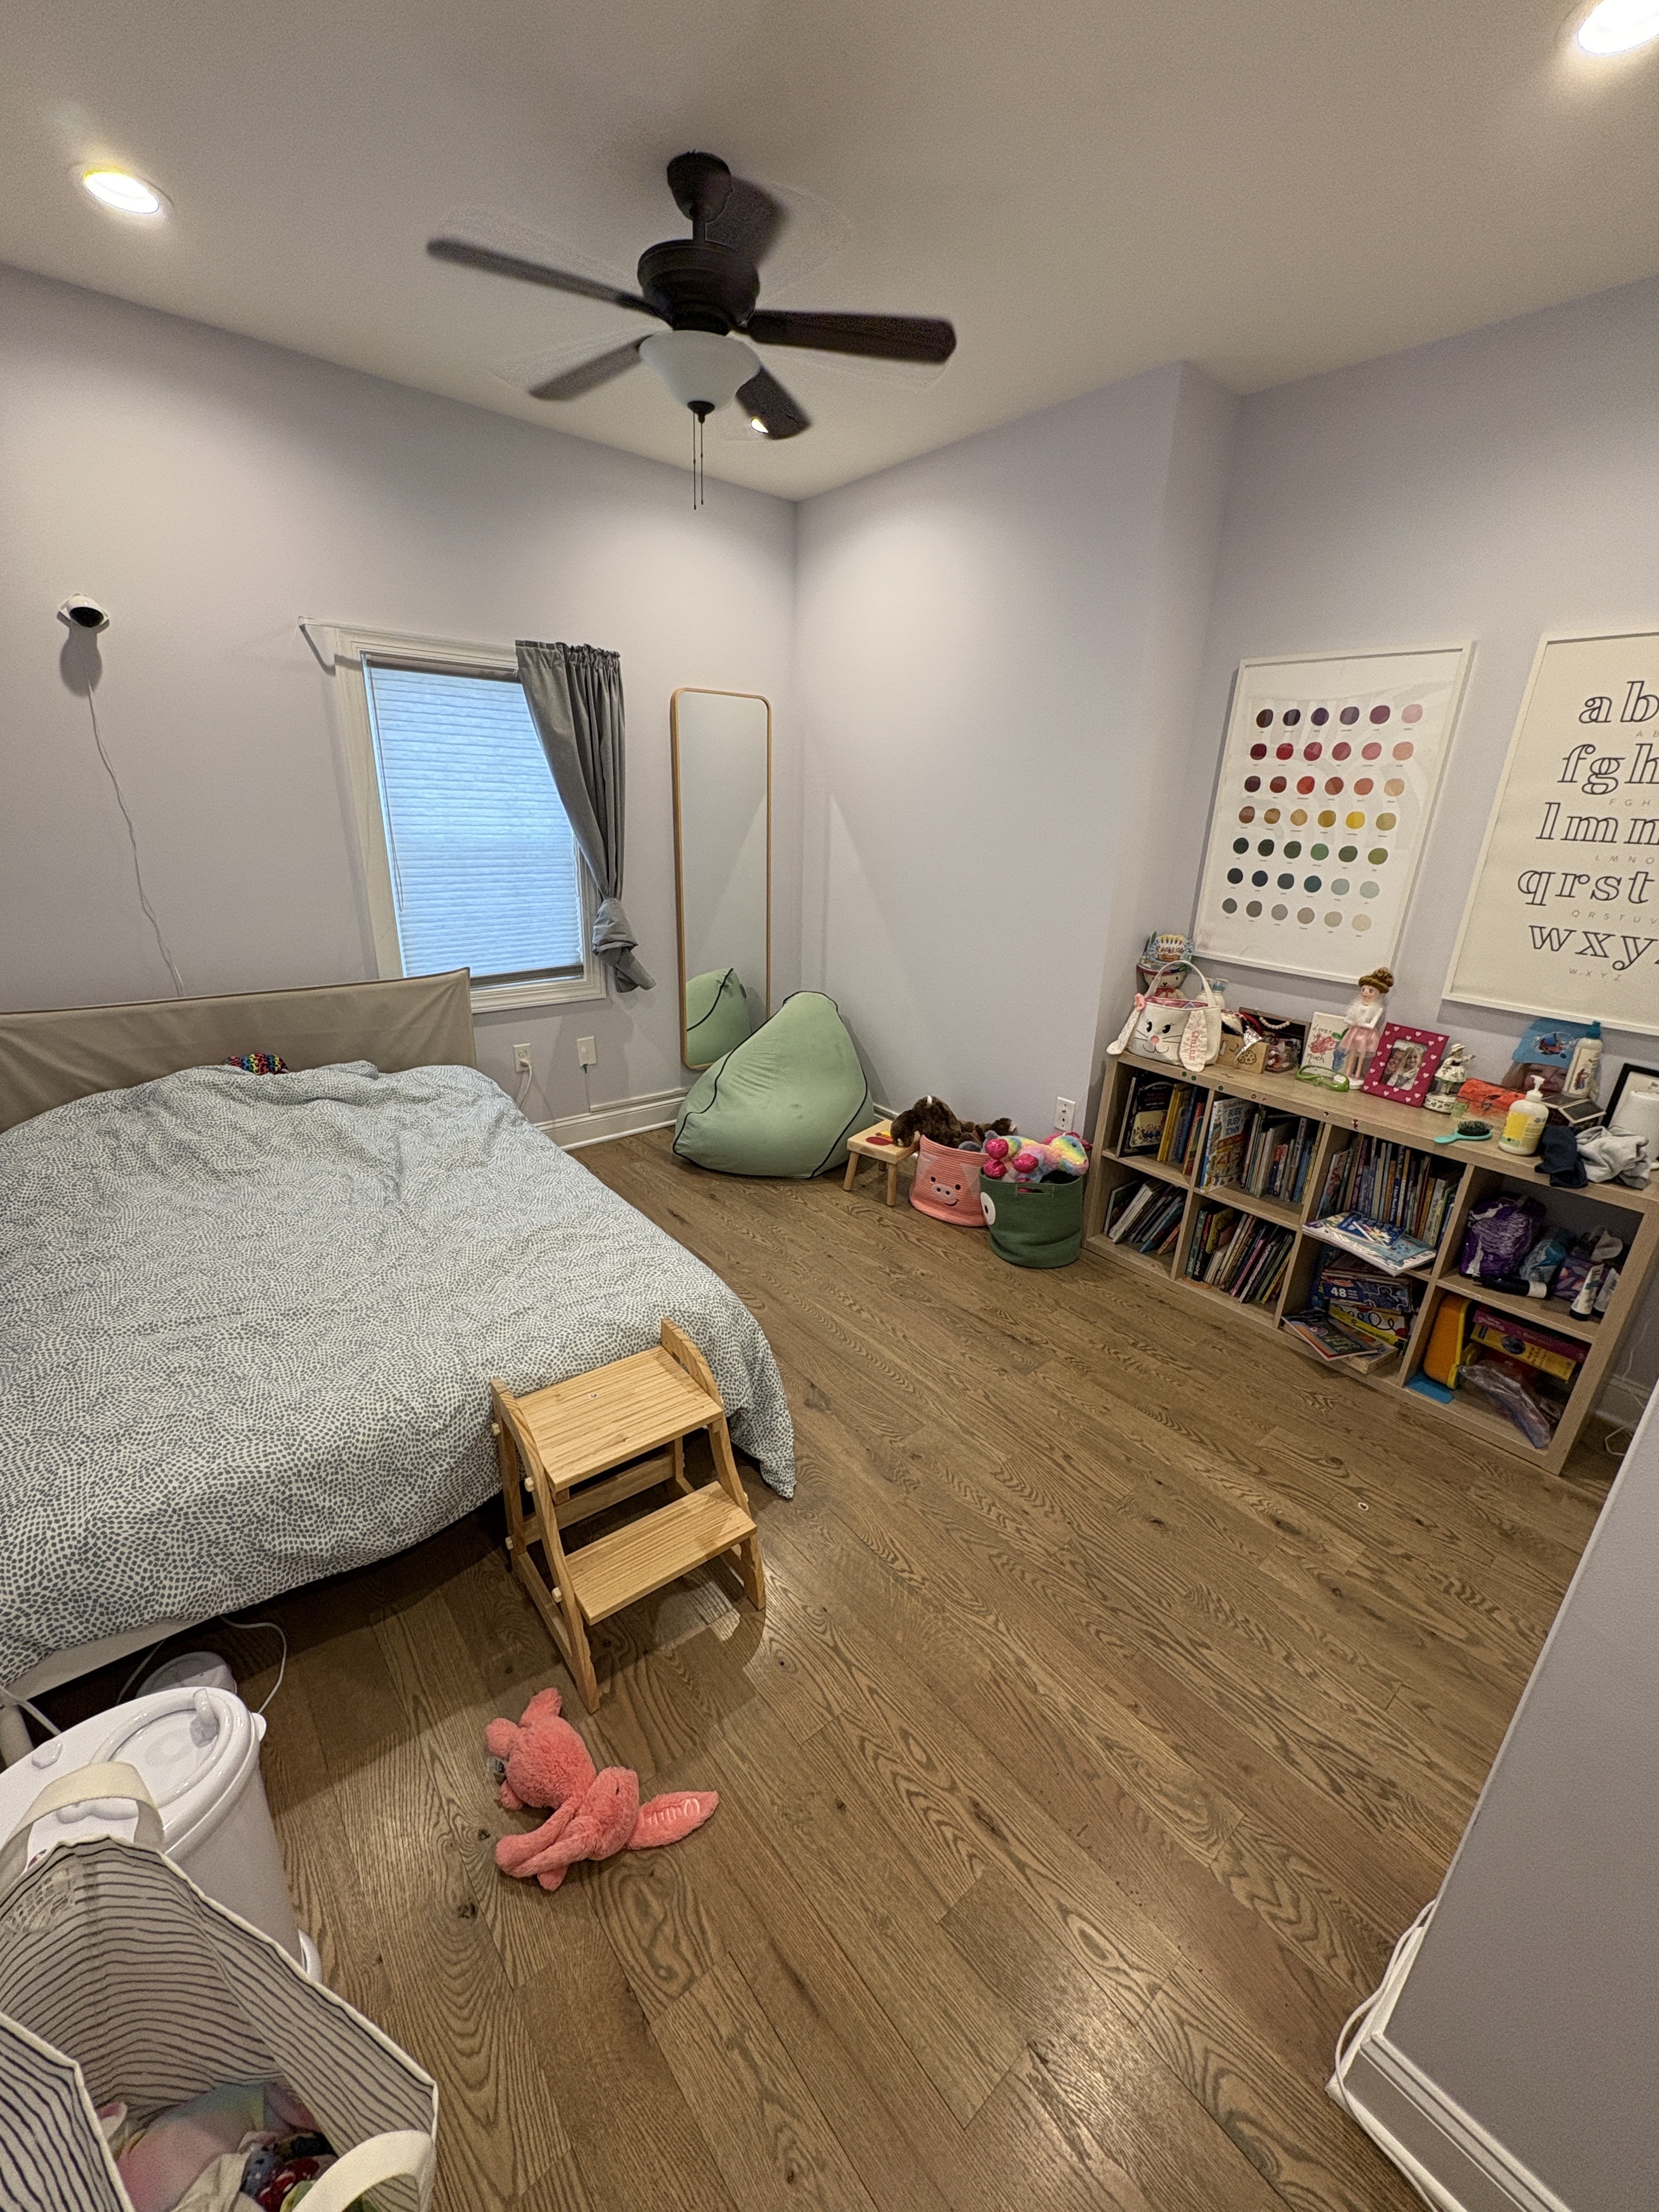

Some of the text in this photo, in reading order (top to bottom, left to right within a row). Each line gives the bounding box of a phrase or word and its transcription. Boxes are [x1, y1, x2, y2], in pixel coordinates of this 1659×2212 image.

[1528, 925, 1659, 971] wxy
[1189, 1031, 1200, 1060] Quinn
[1227, 1116, 1240, 1127] BUSY
[1330, 1287, 1347, 1297] 48
